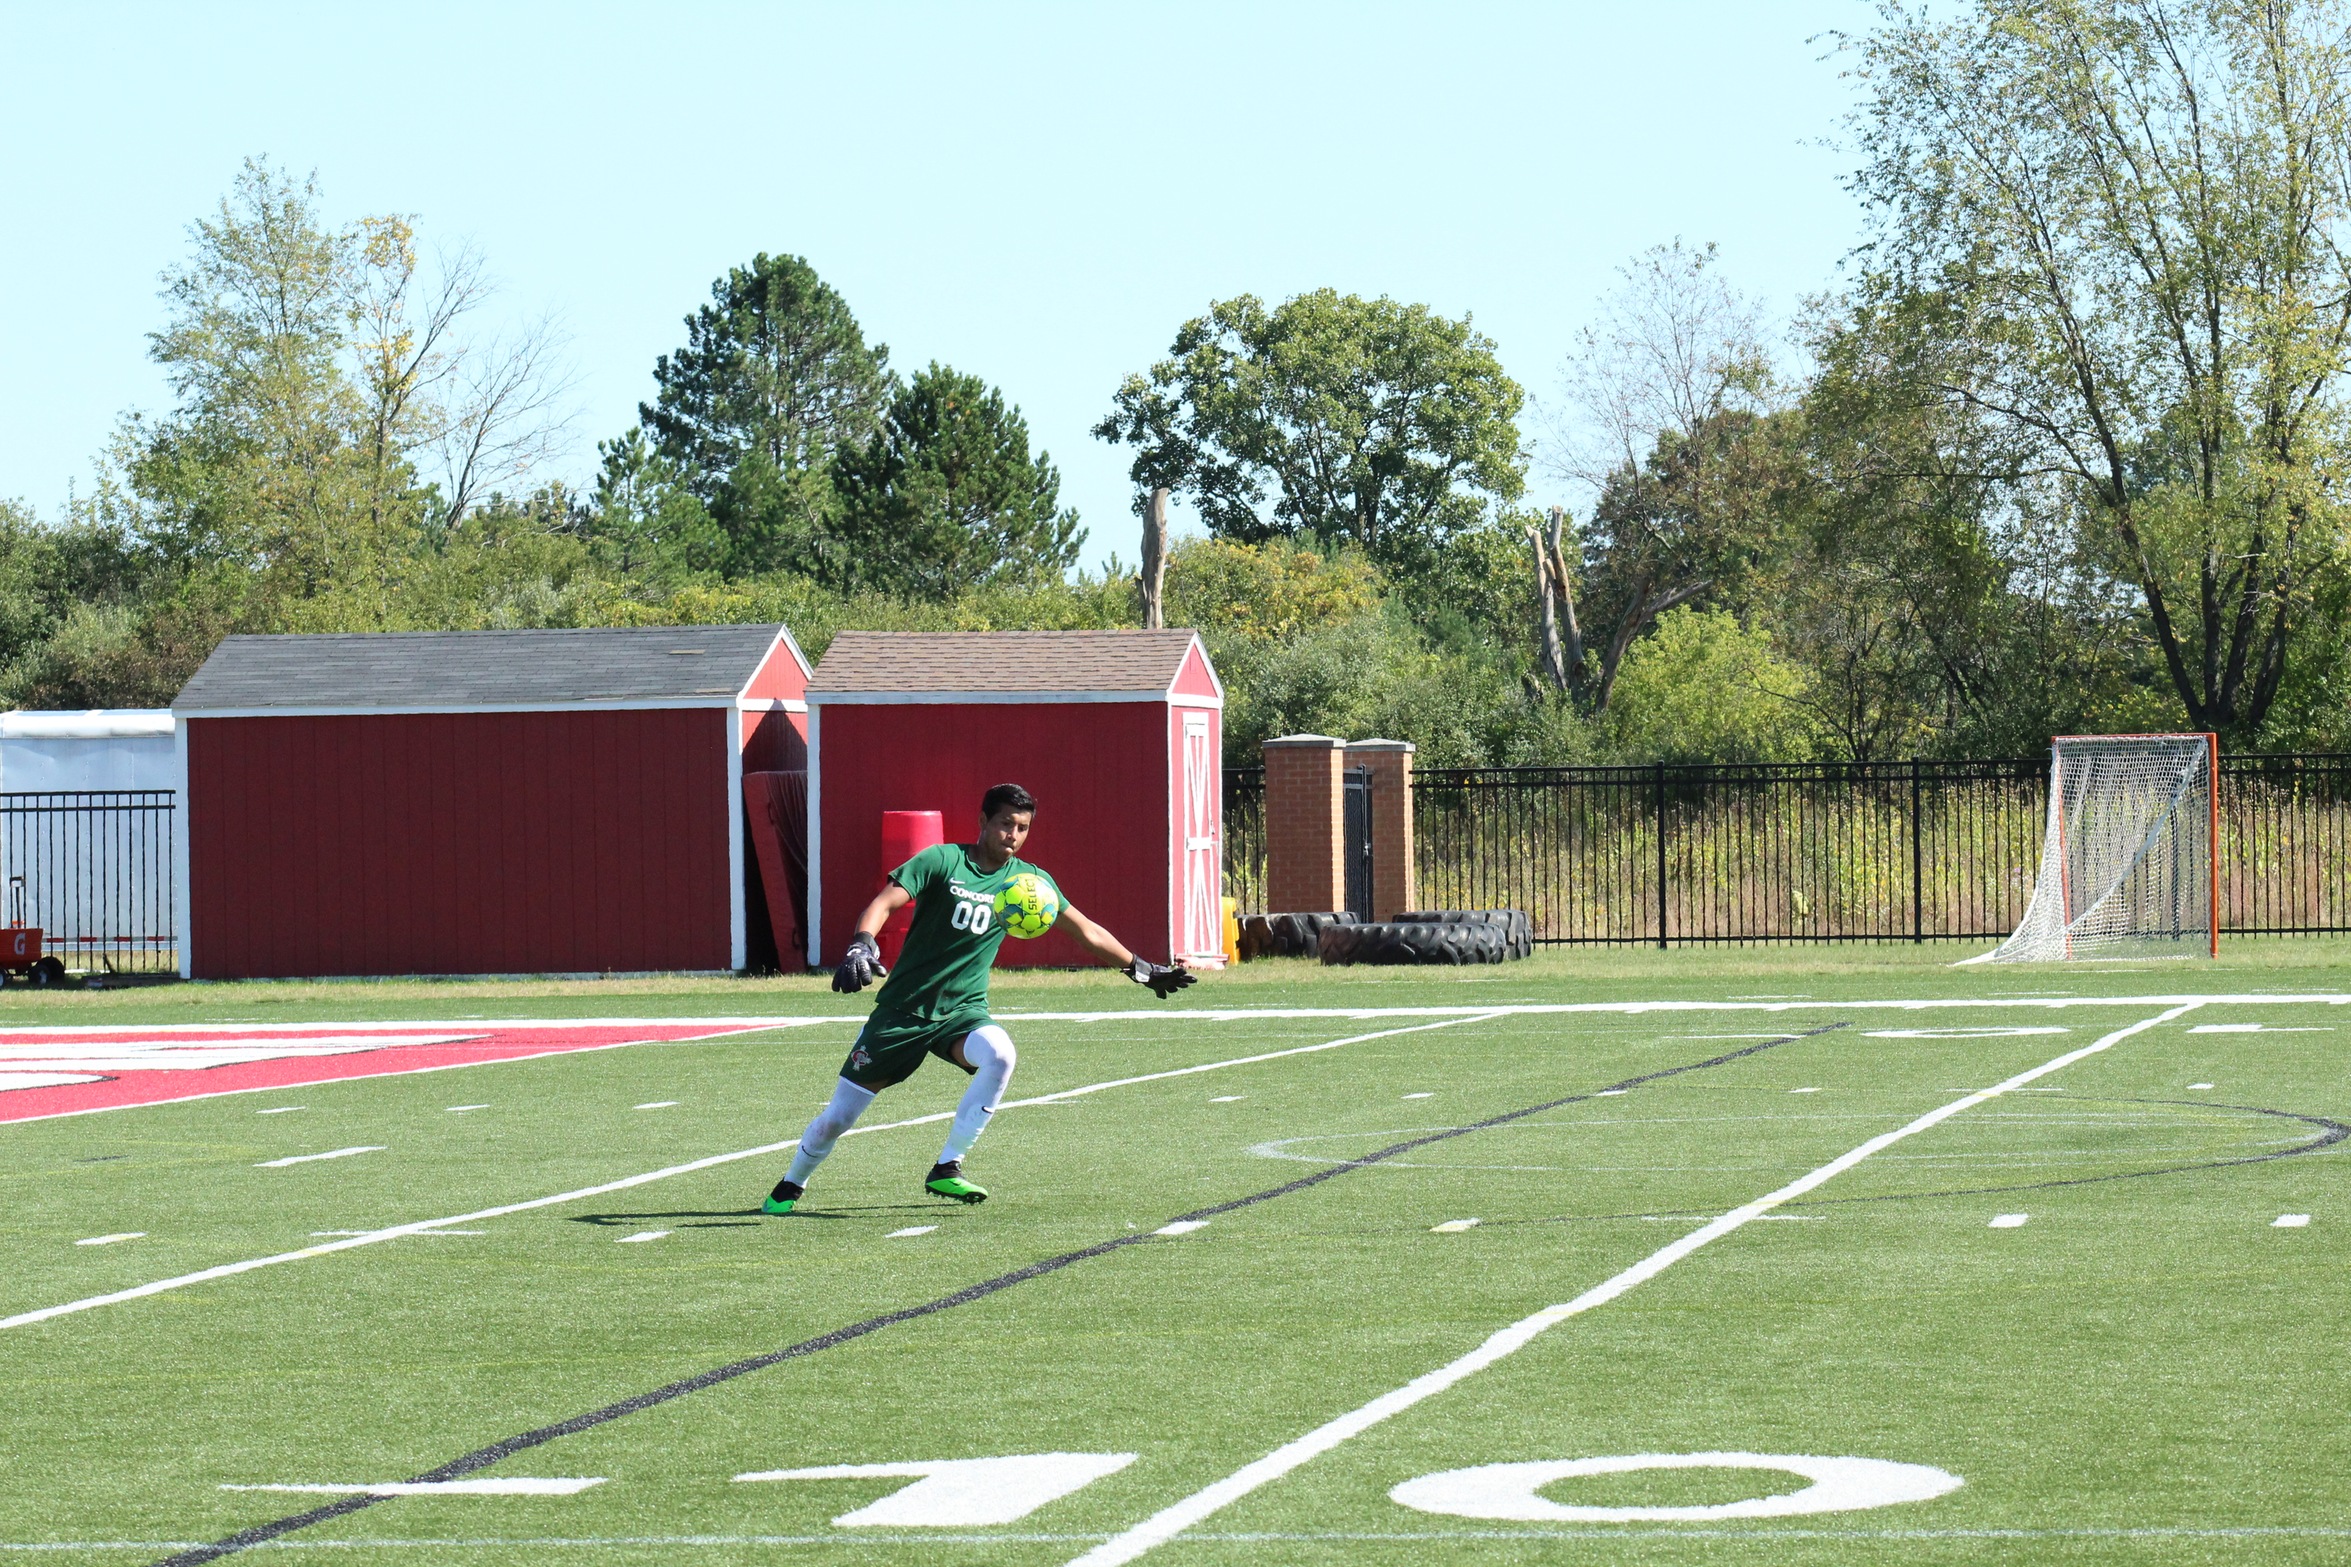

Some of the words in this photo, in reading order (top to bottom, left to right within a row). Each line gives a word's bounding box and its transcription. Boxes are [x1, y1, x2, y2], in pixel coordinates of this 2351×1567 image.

[1026, 877, 1037, 910] SELECT
[951, 900, 991, 935] 00
[14, 932, 26, 955] G
